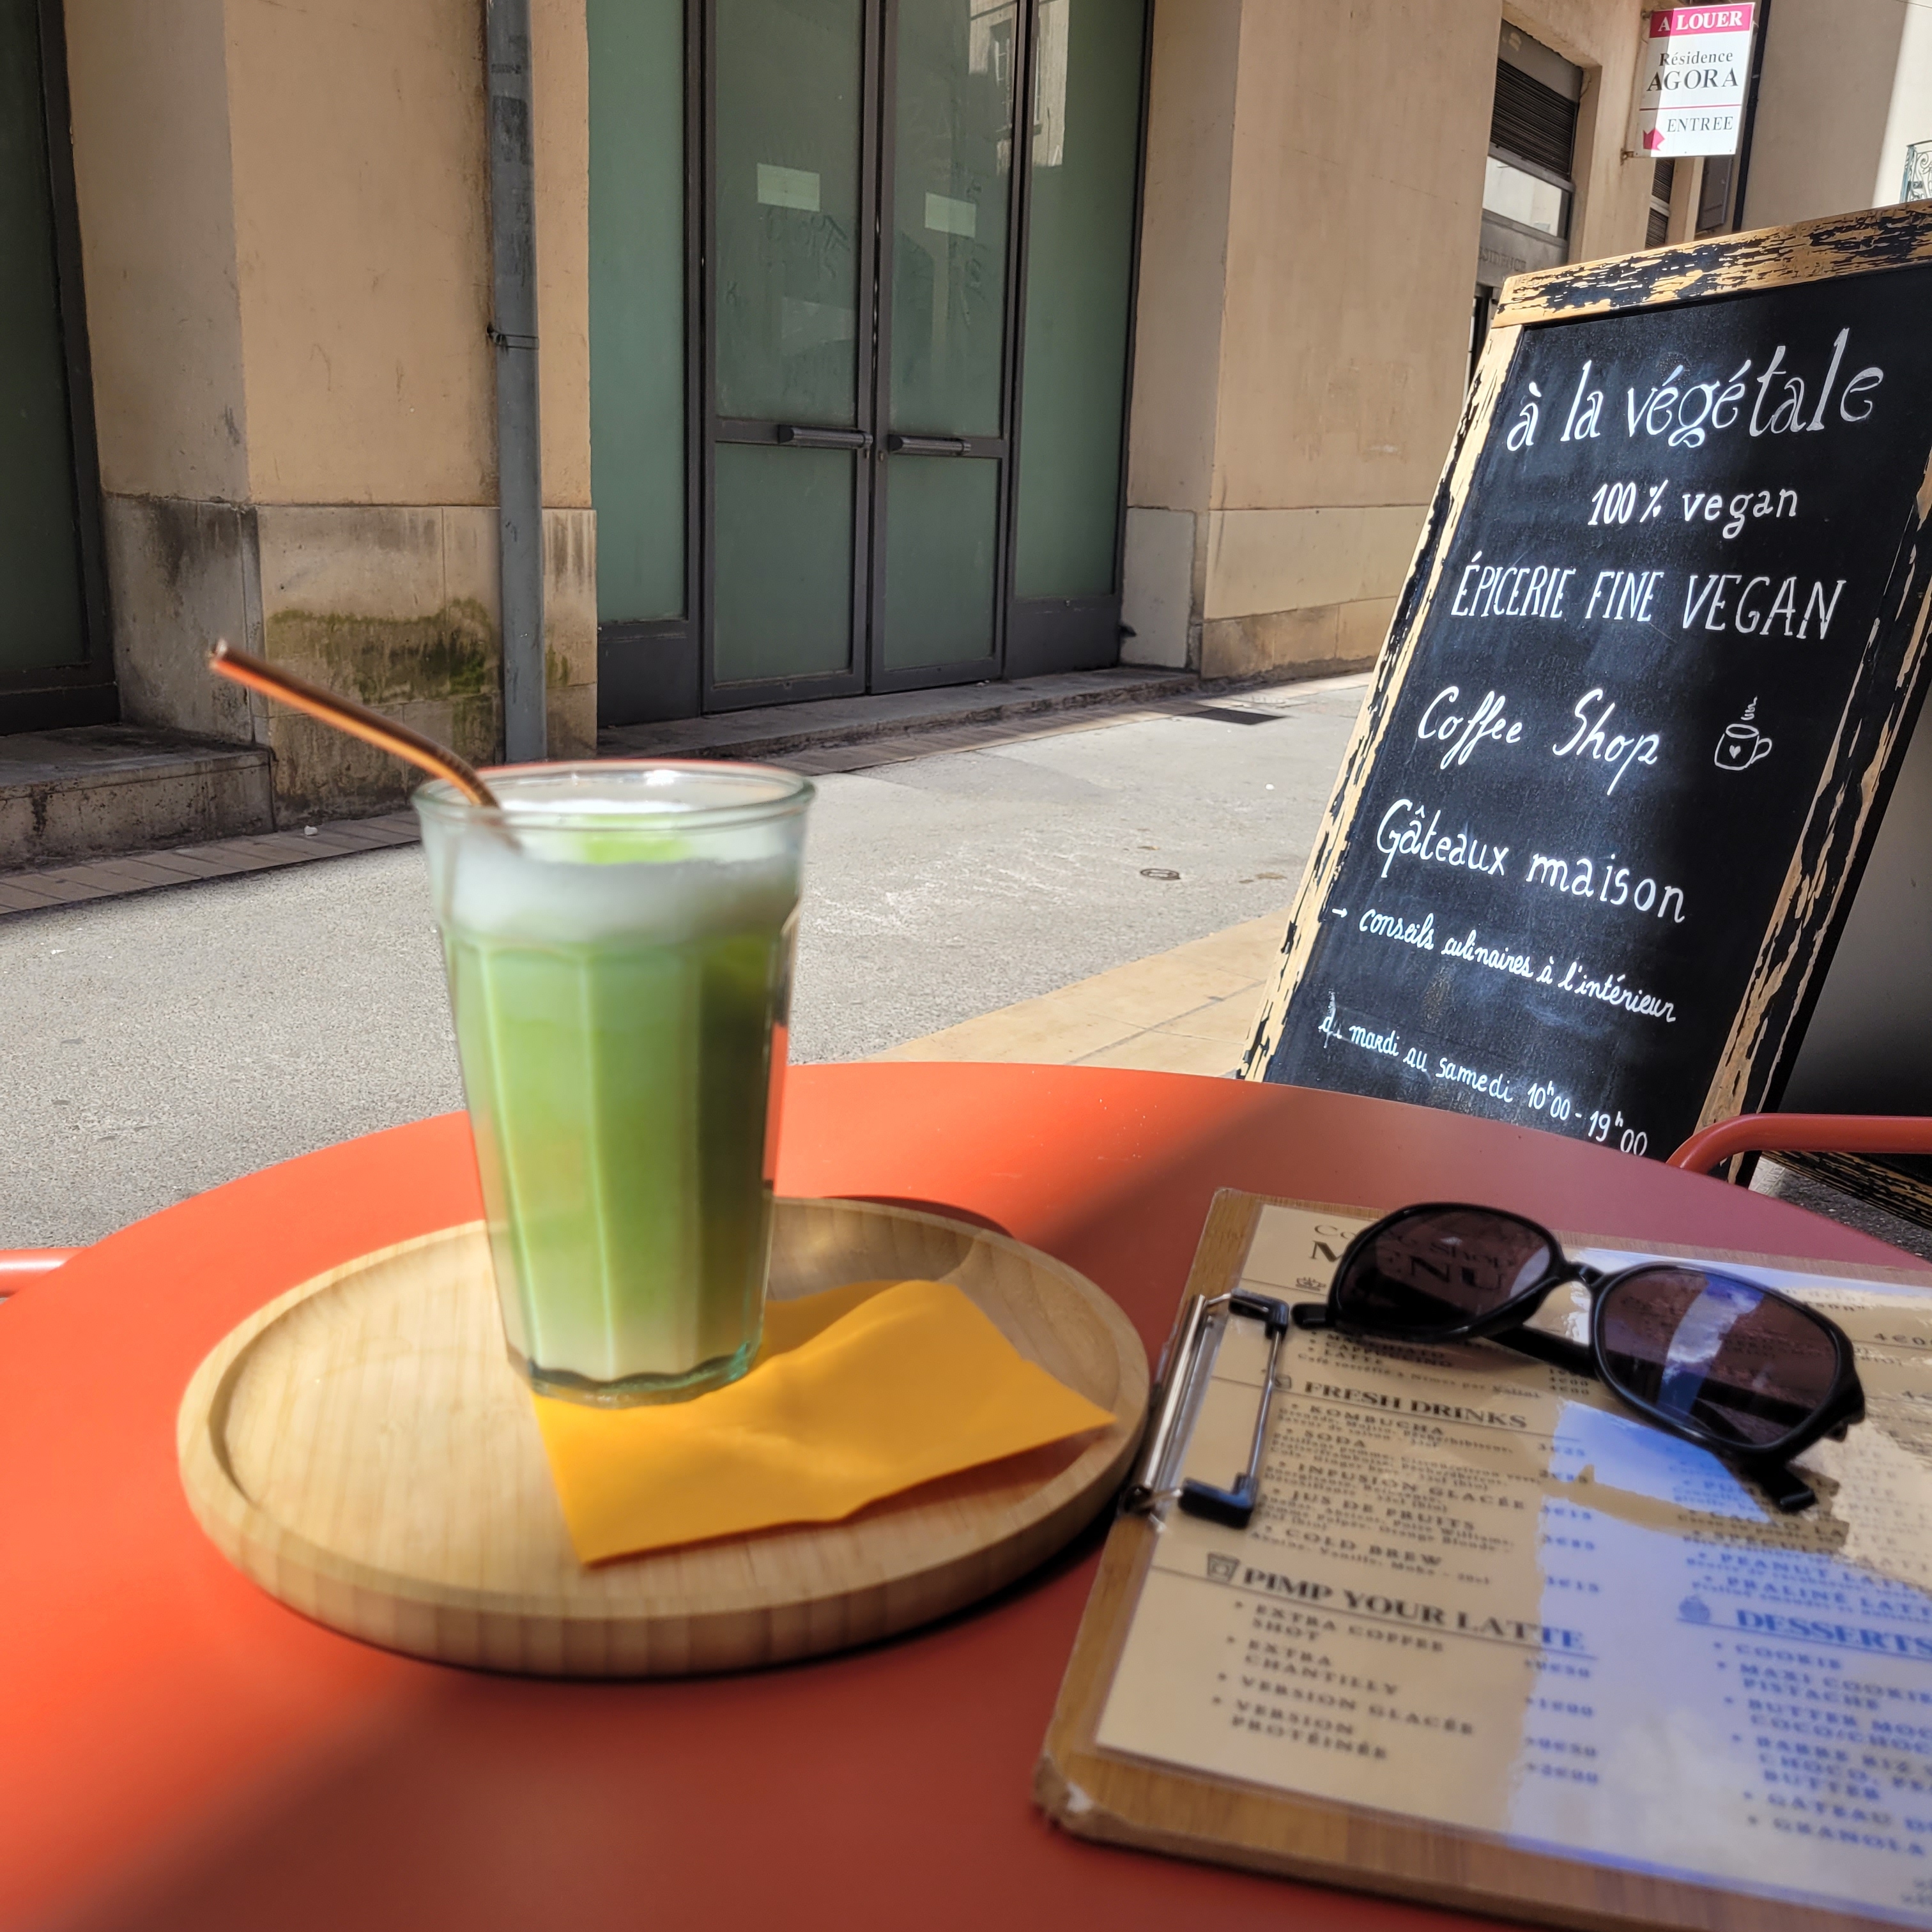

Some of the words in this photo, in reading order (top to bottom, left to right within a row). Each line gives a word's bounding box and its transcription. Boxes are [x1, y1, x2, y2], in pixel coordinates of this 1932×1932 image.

[1658, 17, 1670, 32] A
[1676, 11, 1742, 30] LOUER
[1659, 50, 1733, 66] Résidence
[1646, 68, 1738, 91] AGORA
[1667, 116, 1733, 132] ENTREE
[1506, 382, 1538, 452] à
[1561, 360, 1601, 441] la
[1628, 328, 1884, 447] végétale
[1682, 489, 1798, 539] vegan
[1451, 551, 1575, 619] ÉPICERIE
[1585, 571, 1664, 622] FINE
[1682, 574, 1846, 640] VEGAN
[1417, 686, 1522, 769] Coffee
[1552, 688, 1660, 795] Shop
[1376, 799, 1510, 878] Gâteaux
[1525, 854, 1685, 923] maison
[1359, 909, 1434, 949] conseils
[1441, 930, 1533, 978] culinaires
[1536, 956, 1554, 984] à
[1558, 958, 1676, 1022] l'intérieur
[1349, 1025, 1399, 1056] mardi
[1403, 1047, 1428, 1072] au
[1435, 1056, 1513, 1103] samedi
[1305, 1381, 1401, 1409] FRESH
[1411, 1399, 1527, 1429] DRINKS
[1310, 1405, 1444, 1436] KOMBUCHA
[1305, 1429, 1365, 1448] SODA
[1298, 1462, 1418, 1493] INFUSION
[1285, 1528, 1358, 1551] COLD
[1368, 1544, 1442, 1565] BREW
[1243, 1567, 1334, 1601] PIMP
[1343, 1588, 1446, 1626] YOUR
[1457, 1611, 1585, 1650] LATTE
[1859, 1596, 1932, 1619] LATT
[1255, 1603, 1337, 1632] EXTRA
[1348, 1625, 1445, 1652] COFFEE
[1736, 1608, 1932, 1655] DESSERTS
[1248, 1639, 1331, 1667] EXTRA
[1735, 1644, 1842, 1671] COOKIE
[1241, 1675, 1357, 1710] VERSION
[1244, 1654, 1399, 1696] CHANTILLY
[1236, 1699, 1355, 1735] VERSION
